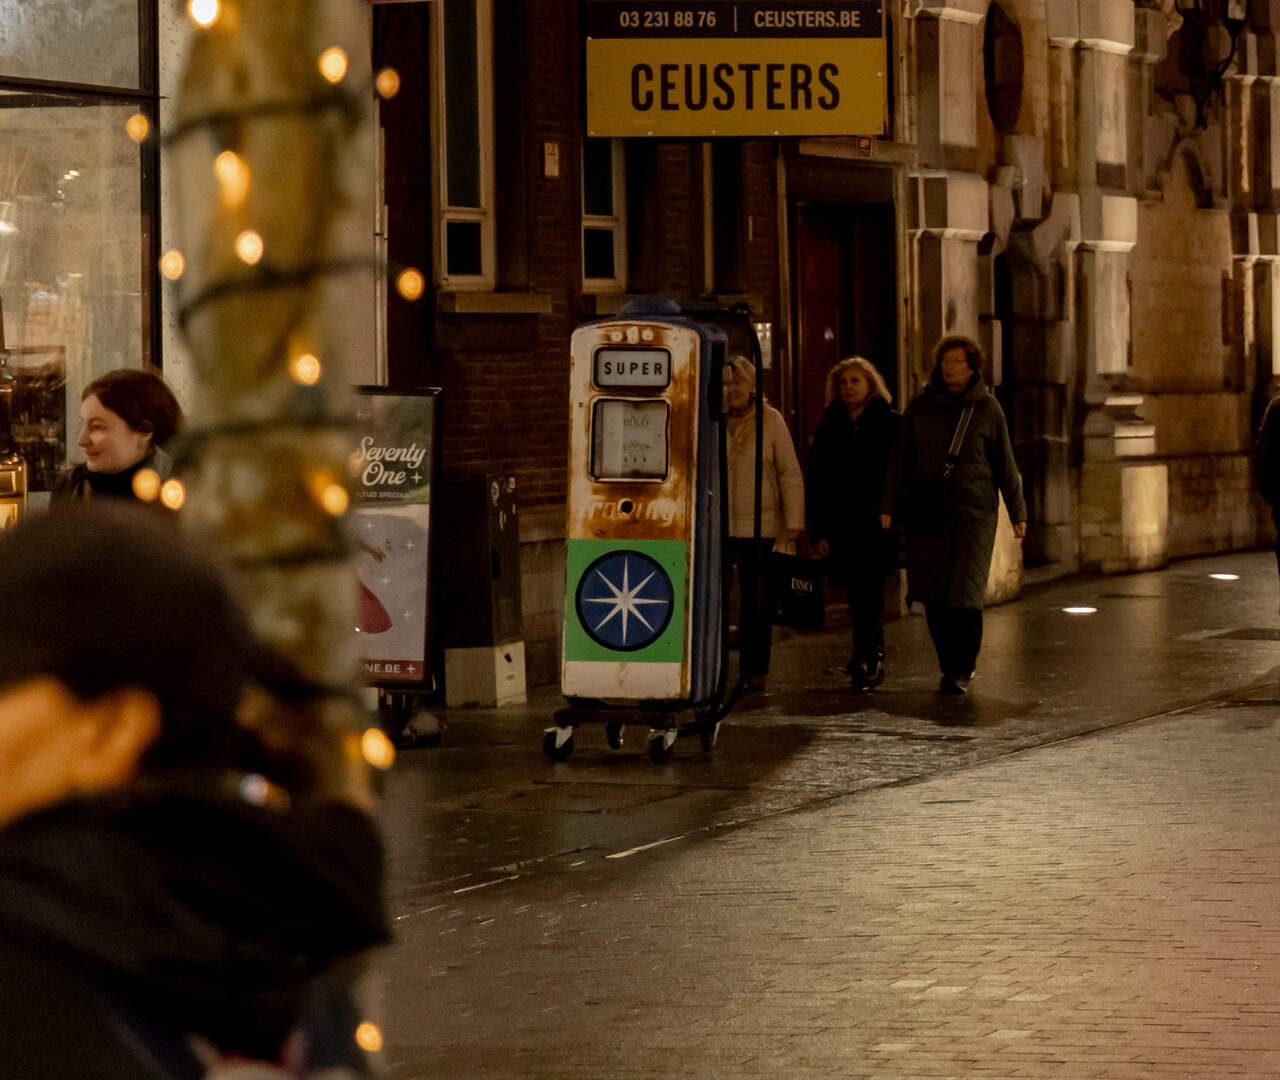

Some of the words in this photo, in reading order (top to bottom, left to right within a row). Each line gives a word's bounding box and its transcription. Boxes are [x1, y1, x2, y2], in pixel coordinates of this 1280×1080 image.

[619, 11, 640, 29] 03
[643, 11, 670, 29] 231
[672, 11, 694, 29] 88
[697, 11, 717, 29] 76
[753, 10, 861, 29] CEUSTERS.BE
[630, 62, 841, 112] CEUSTERS
[603, 360, 664, 377] SUPER
[359, 435, 427, 470] Seventy
[361, 460, 408, 487] One
